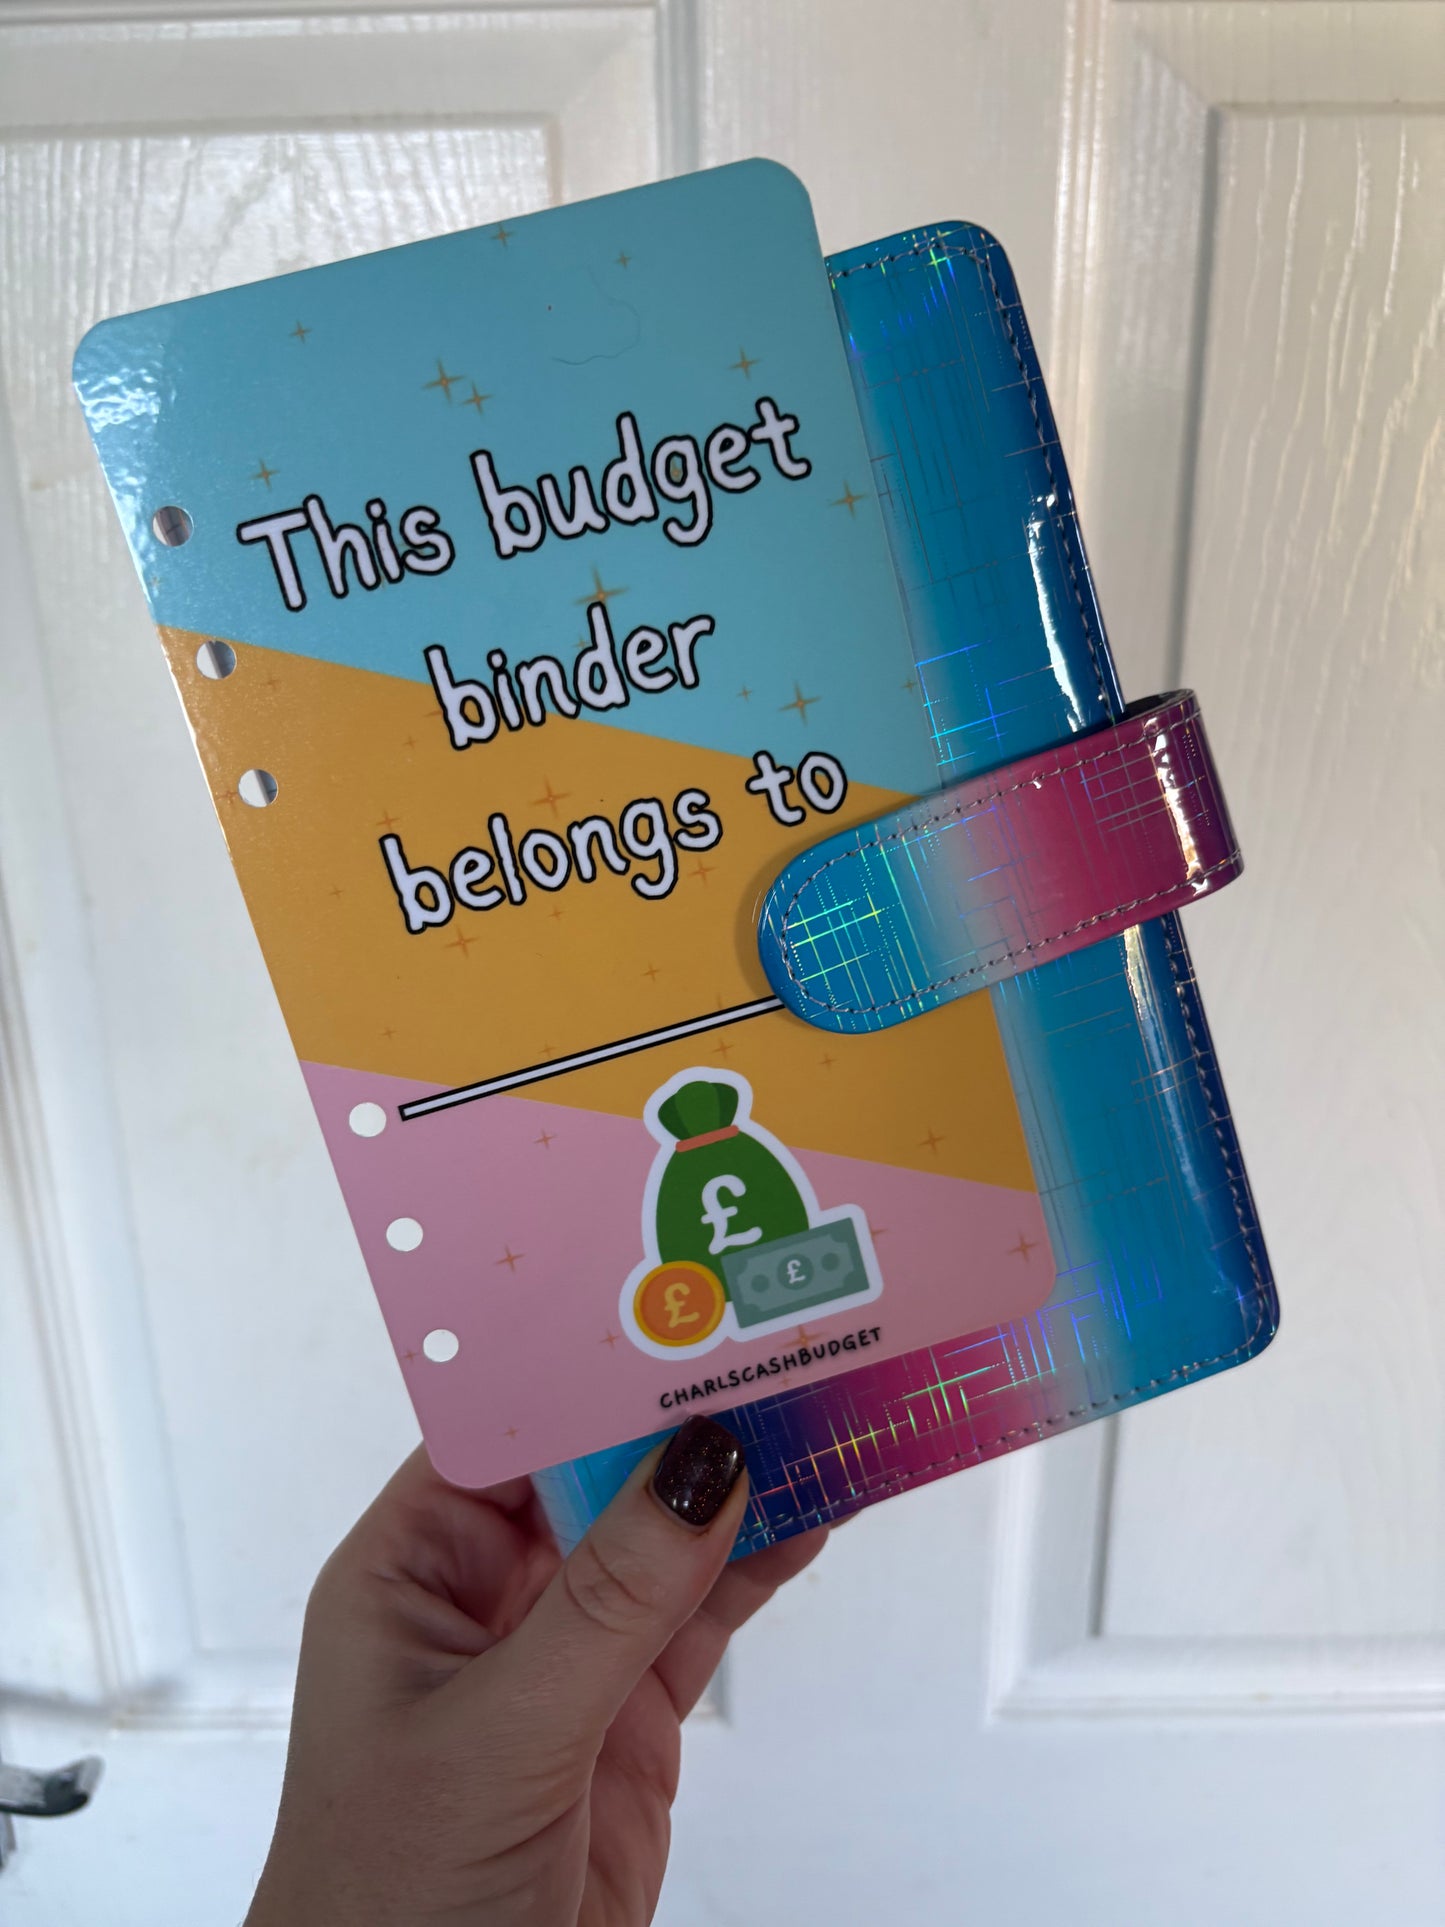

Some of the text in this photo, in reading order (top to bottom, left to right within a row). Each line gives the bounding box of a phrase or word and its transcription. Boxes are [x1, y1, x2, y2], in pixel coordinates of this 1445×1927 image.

[237, 397, 811, 611] This budget
[424, 602, 715, 749] binder
[380, 750, 847, 933] belongs to
[701, 1174, 762, 1255] £
[664, 1282, 699, 1328] £
[786, 1259, 806, 1284] £
[659, 1326, 881, 1409] CHARLSCASHBUDGET
